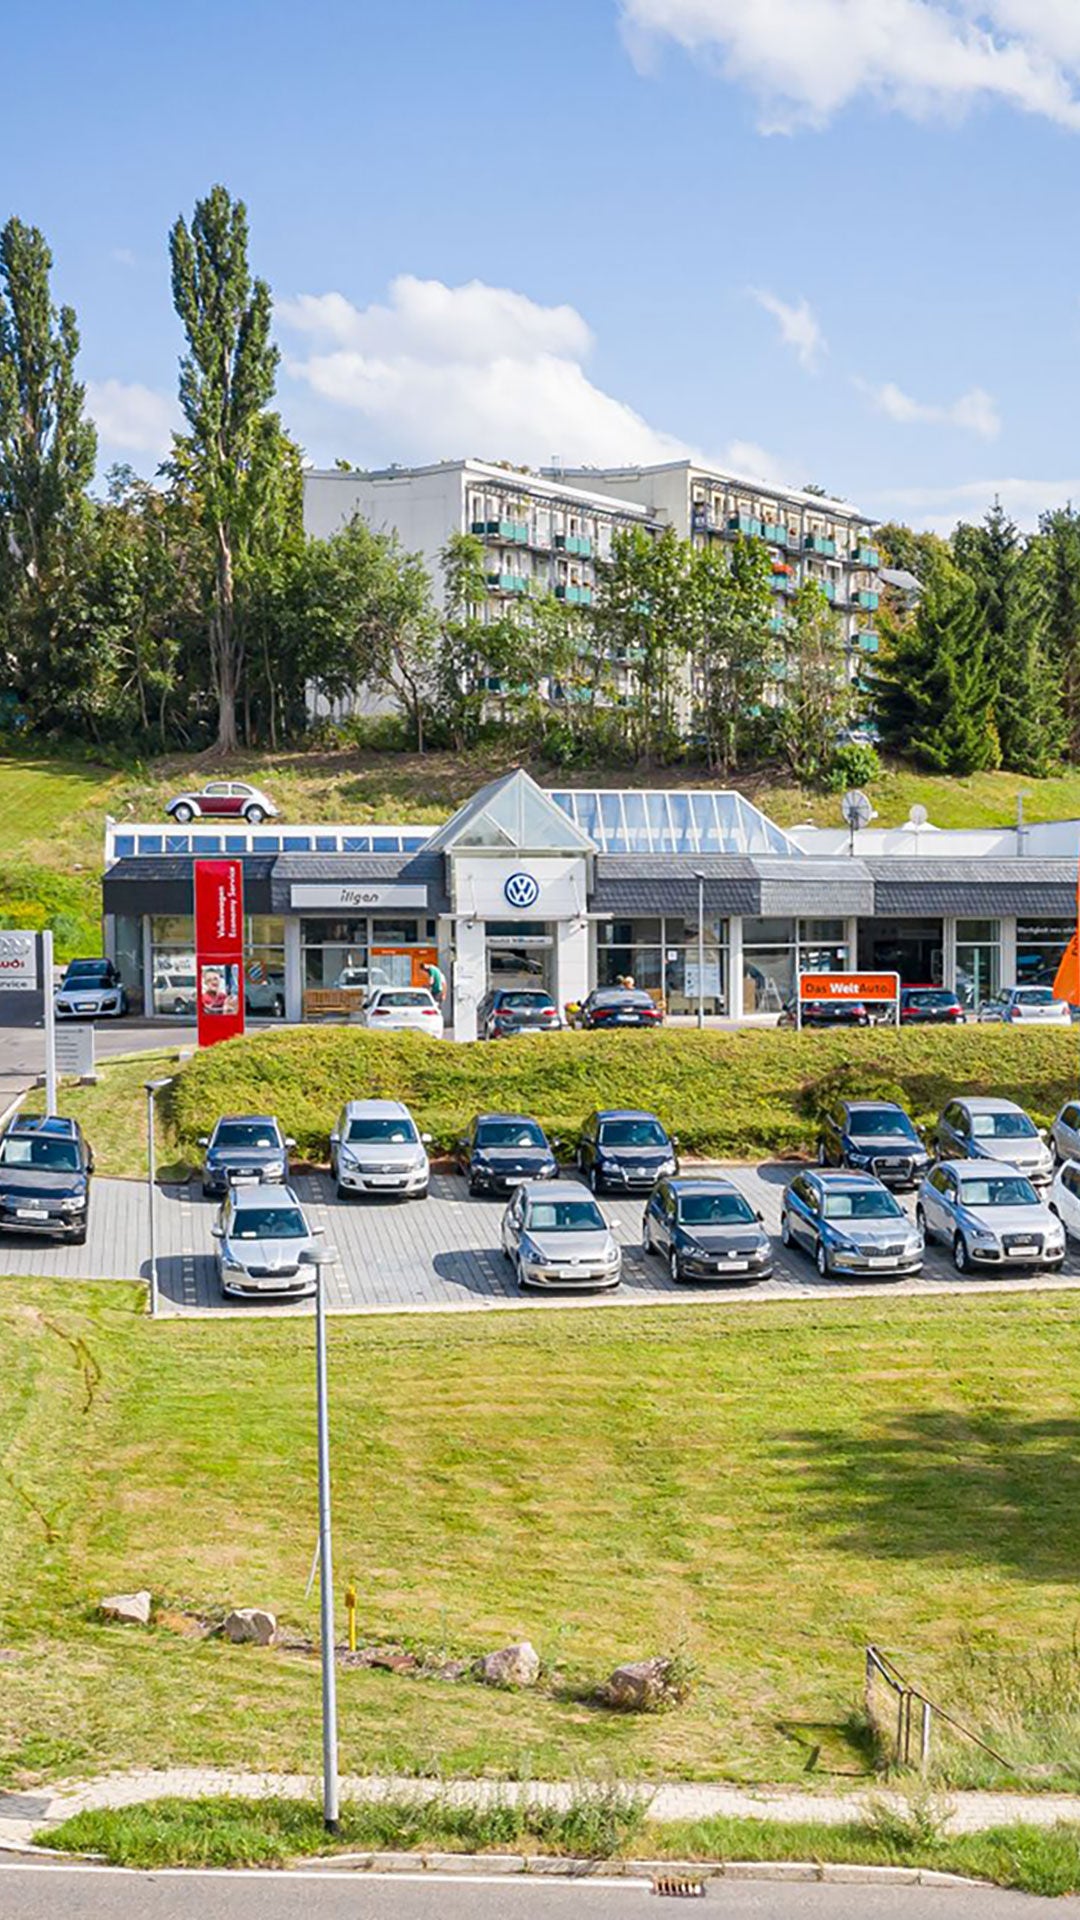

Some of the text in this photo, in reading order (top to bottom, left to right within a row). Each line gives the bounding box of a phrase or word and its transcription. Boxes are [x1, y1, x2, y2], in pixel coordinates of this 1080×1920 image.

[217, 886, 226, 938] Volkswagen
[227, 866, 238, 938] Economy Service
[0, 959, 25, 968] udi
[805, 983, 826, 993] Das
